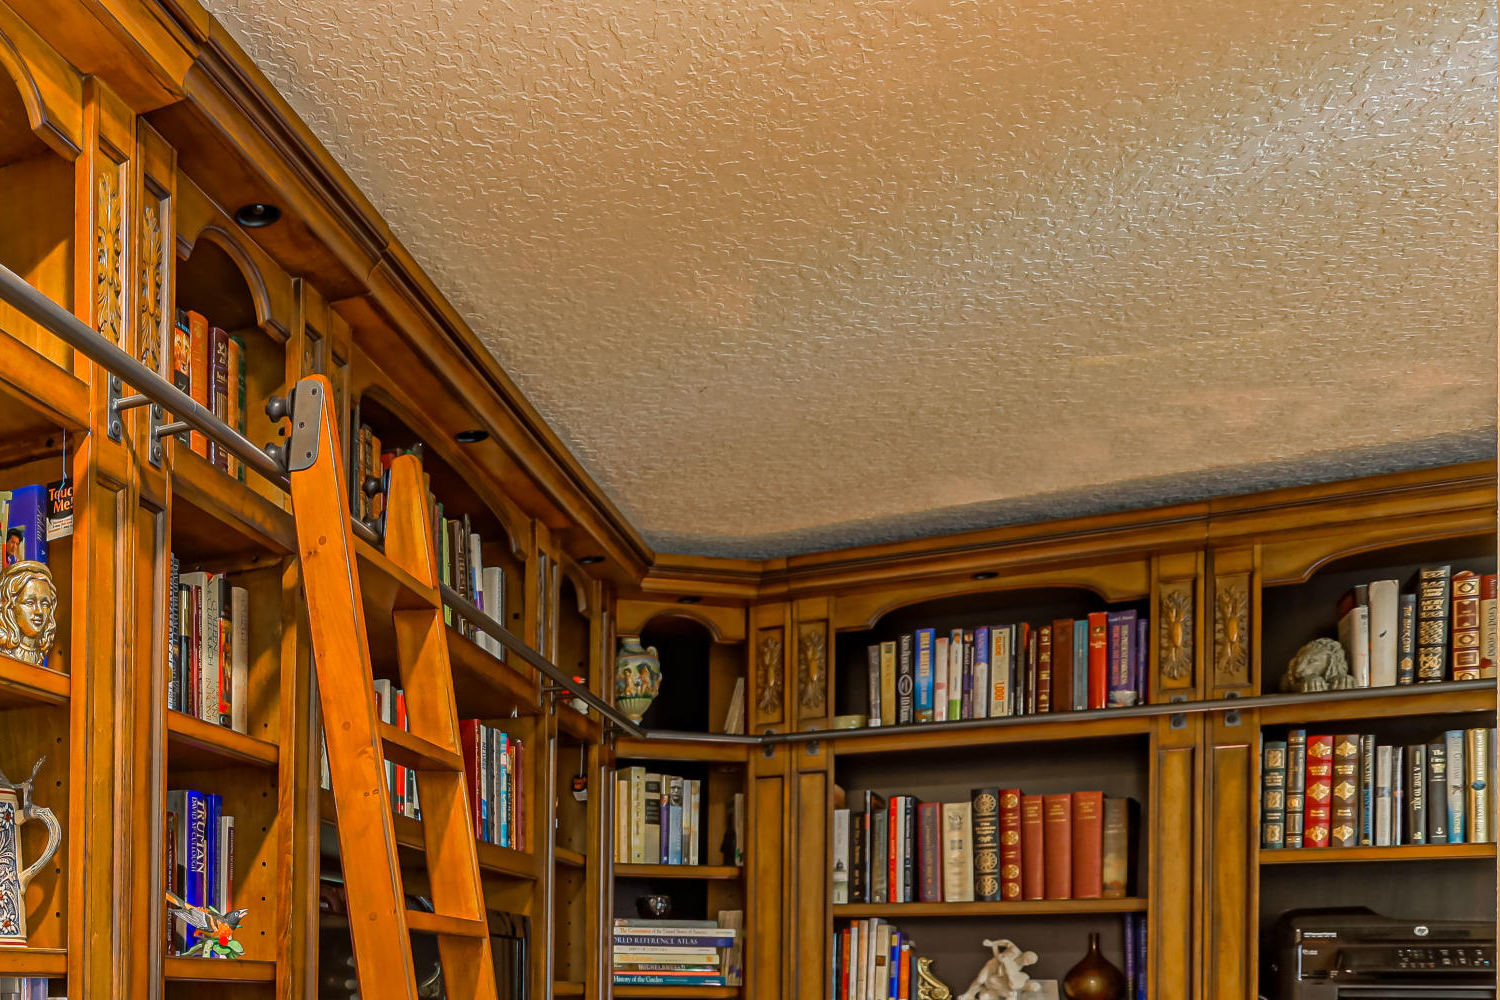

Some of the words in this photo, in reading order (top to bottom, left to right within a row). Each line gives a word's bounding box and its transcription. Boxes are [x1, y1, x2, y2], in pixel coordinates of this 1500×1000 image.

[53, 497, 73, 514] Me!
[211, 600, 219, 652] COLLEEN
[1413, 773, 1422, 788] TIME
[1413, 788, 1421, 798] TO
[1411, 799, 1421, 811] KILL
[196, 800, 205, 873] TRUMAN
[634, 937, 674, 945] REFERENCE
[677, 937, 698, 945] ATLAS
[646, 976, 664, 984] Garden
